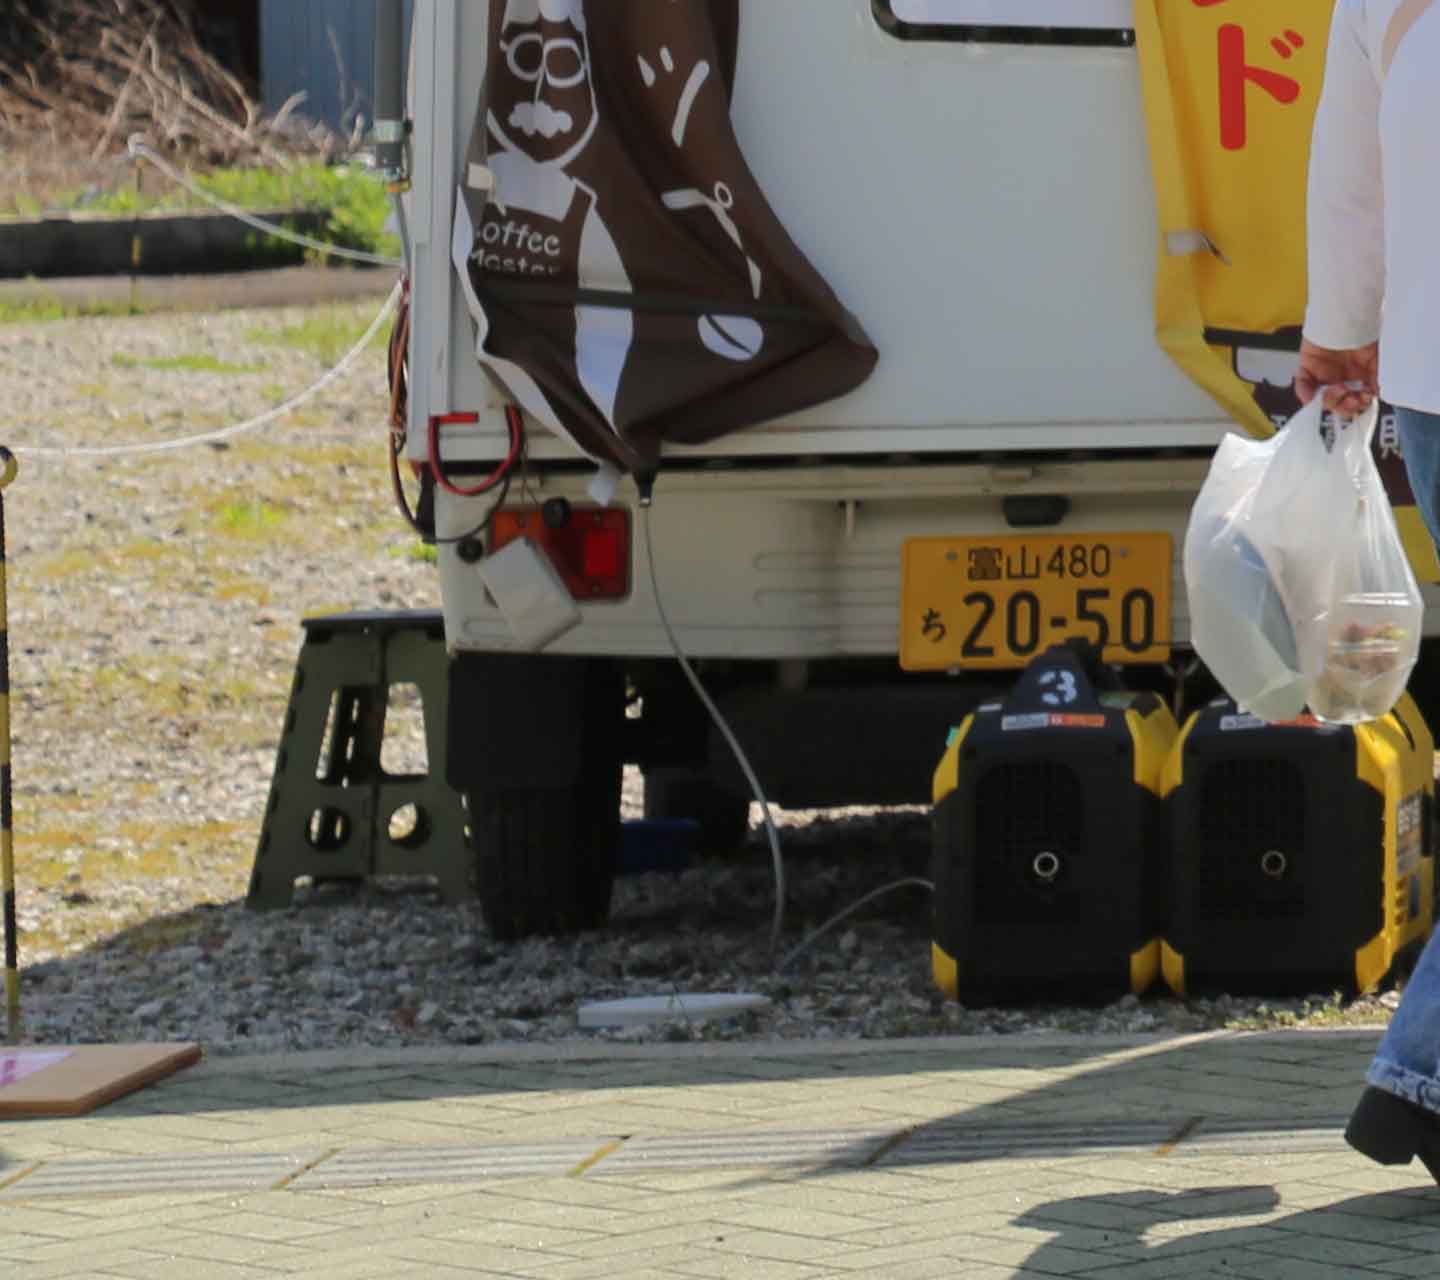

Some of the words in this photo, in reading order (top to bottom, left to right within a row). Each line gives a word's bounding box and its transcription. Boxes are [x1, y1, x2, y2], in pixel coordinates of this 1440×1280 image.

[476, 220, 561, 257] offee
[921, 607, 947, 643] ち
[961, 587, 1156, 659] 20-50
[1038, 669, 1079, 705] 3
